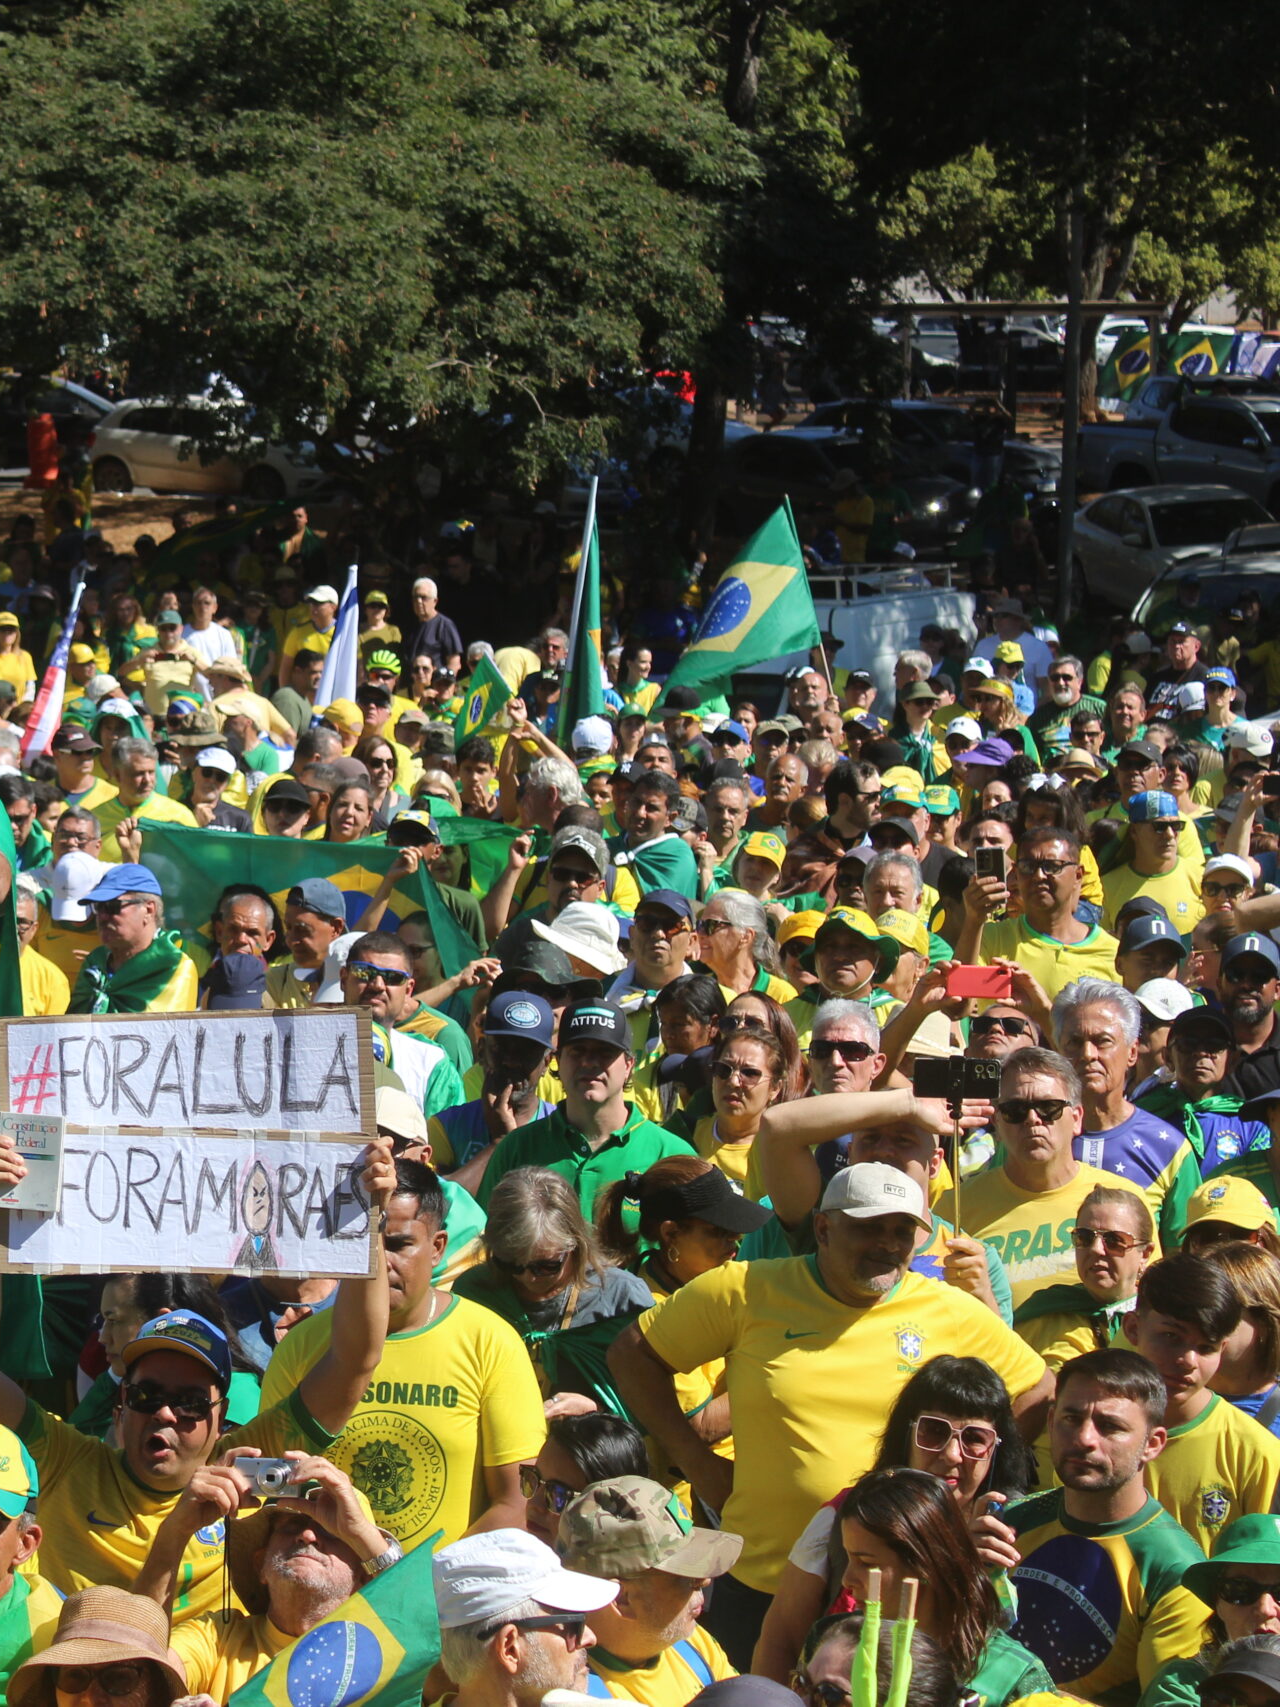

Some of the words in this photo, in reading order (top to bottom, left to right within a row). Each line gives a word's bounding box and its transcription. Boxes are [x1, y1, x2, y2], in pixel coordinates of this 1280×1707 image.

[571, 1015, 616, 1029] ATITUS
[16, 1130, 47, 1149] Federal
[886, 1186, 904, 1195] NYC
[983, 1218, 1078, 1264] BRAS
[360, 1381, 460, 1408] SONARO
[345, 1415, 390, 1437] ACIMA
[392, 1416, 410, 1433] DE
[412, 1426, 442, 1475] TODOS
[412, 1485, 442, 1528] BRASIL
[1016, 1568, 1049, 1582] ORDEM
[1053, 1578, 1061, 1588] E
[1063, 1584, 1113, 1639] PROGRESSO
